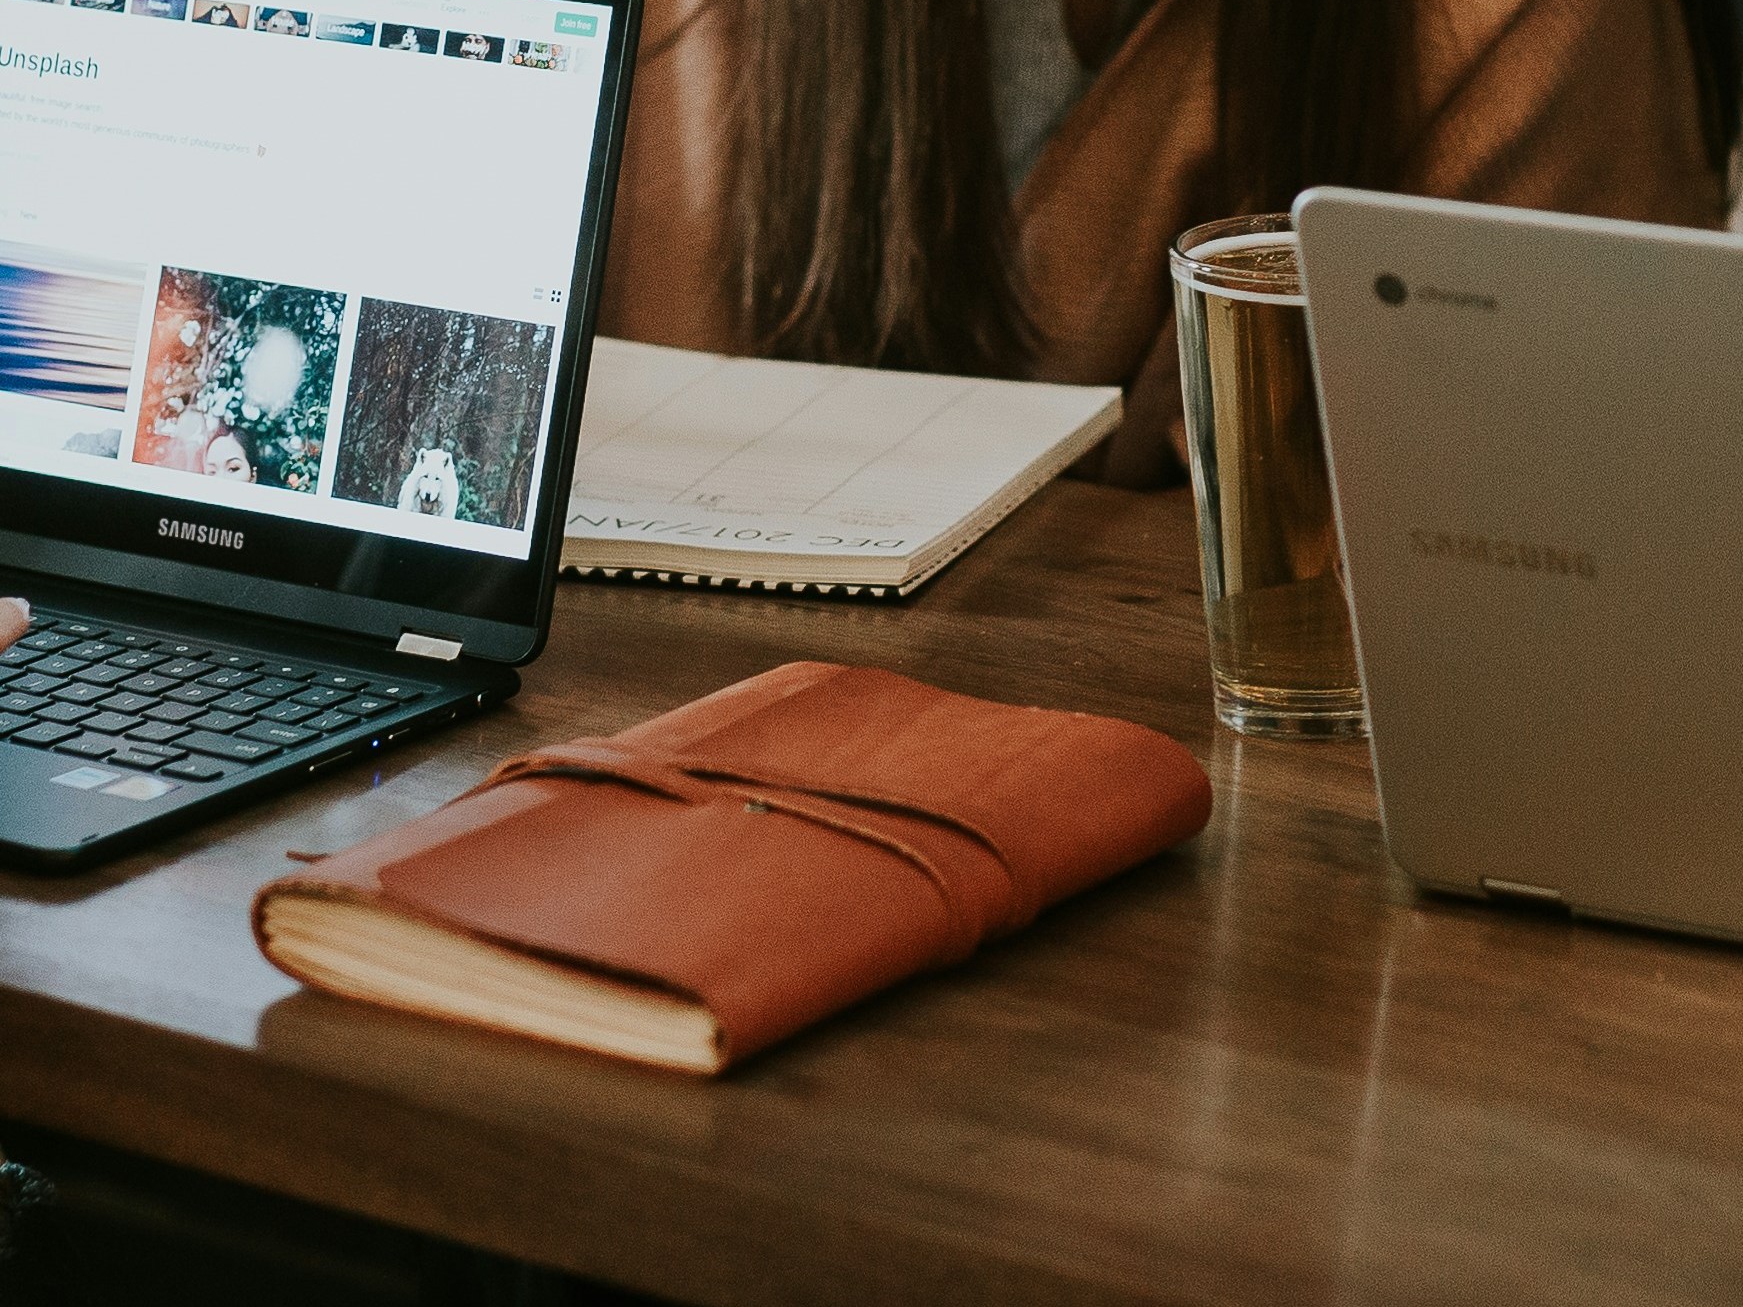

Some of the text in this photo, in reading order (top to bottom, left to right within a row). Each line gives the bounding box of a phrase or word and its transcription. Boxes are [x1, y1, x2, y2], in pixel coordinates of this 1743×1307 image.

[440, 3, 466, 13] Explore
[560, 18, 592, 31] Join free
[133, 129, 177, 144] community
[158, 518, 244, 550] SAMSUNG
[568, 514, 906, 550] DEC 2017/JAN
[1410, 529, 1598, 581] SAMSUNG
